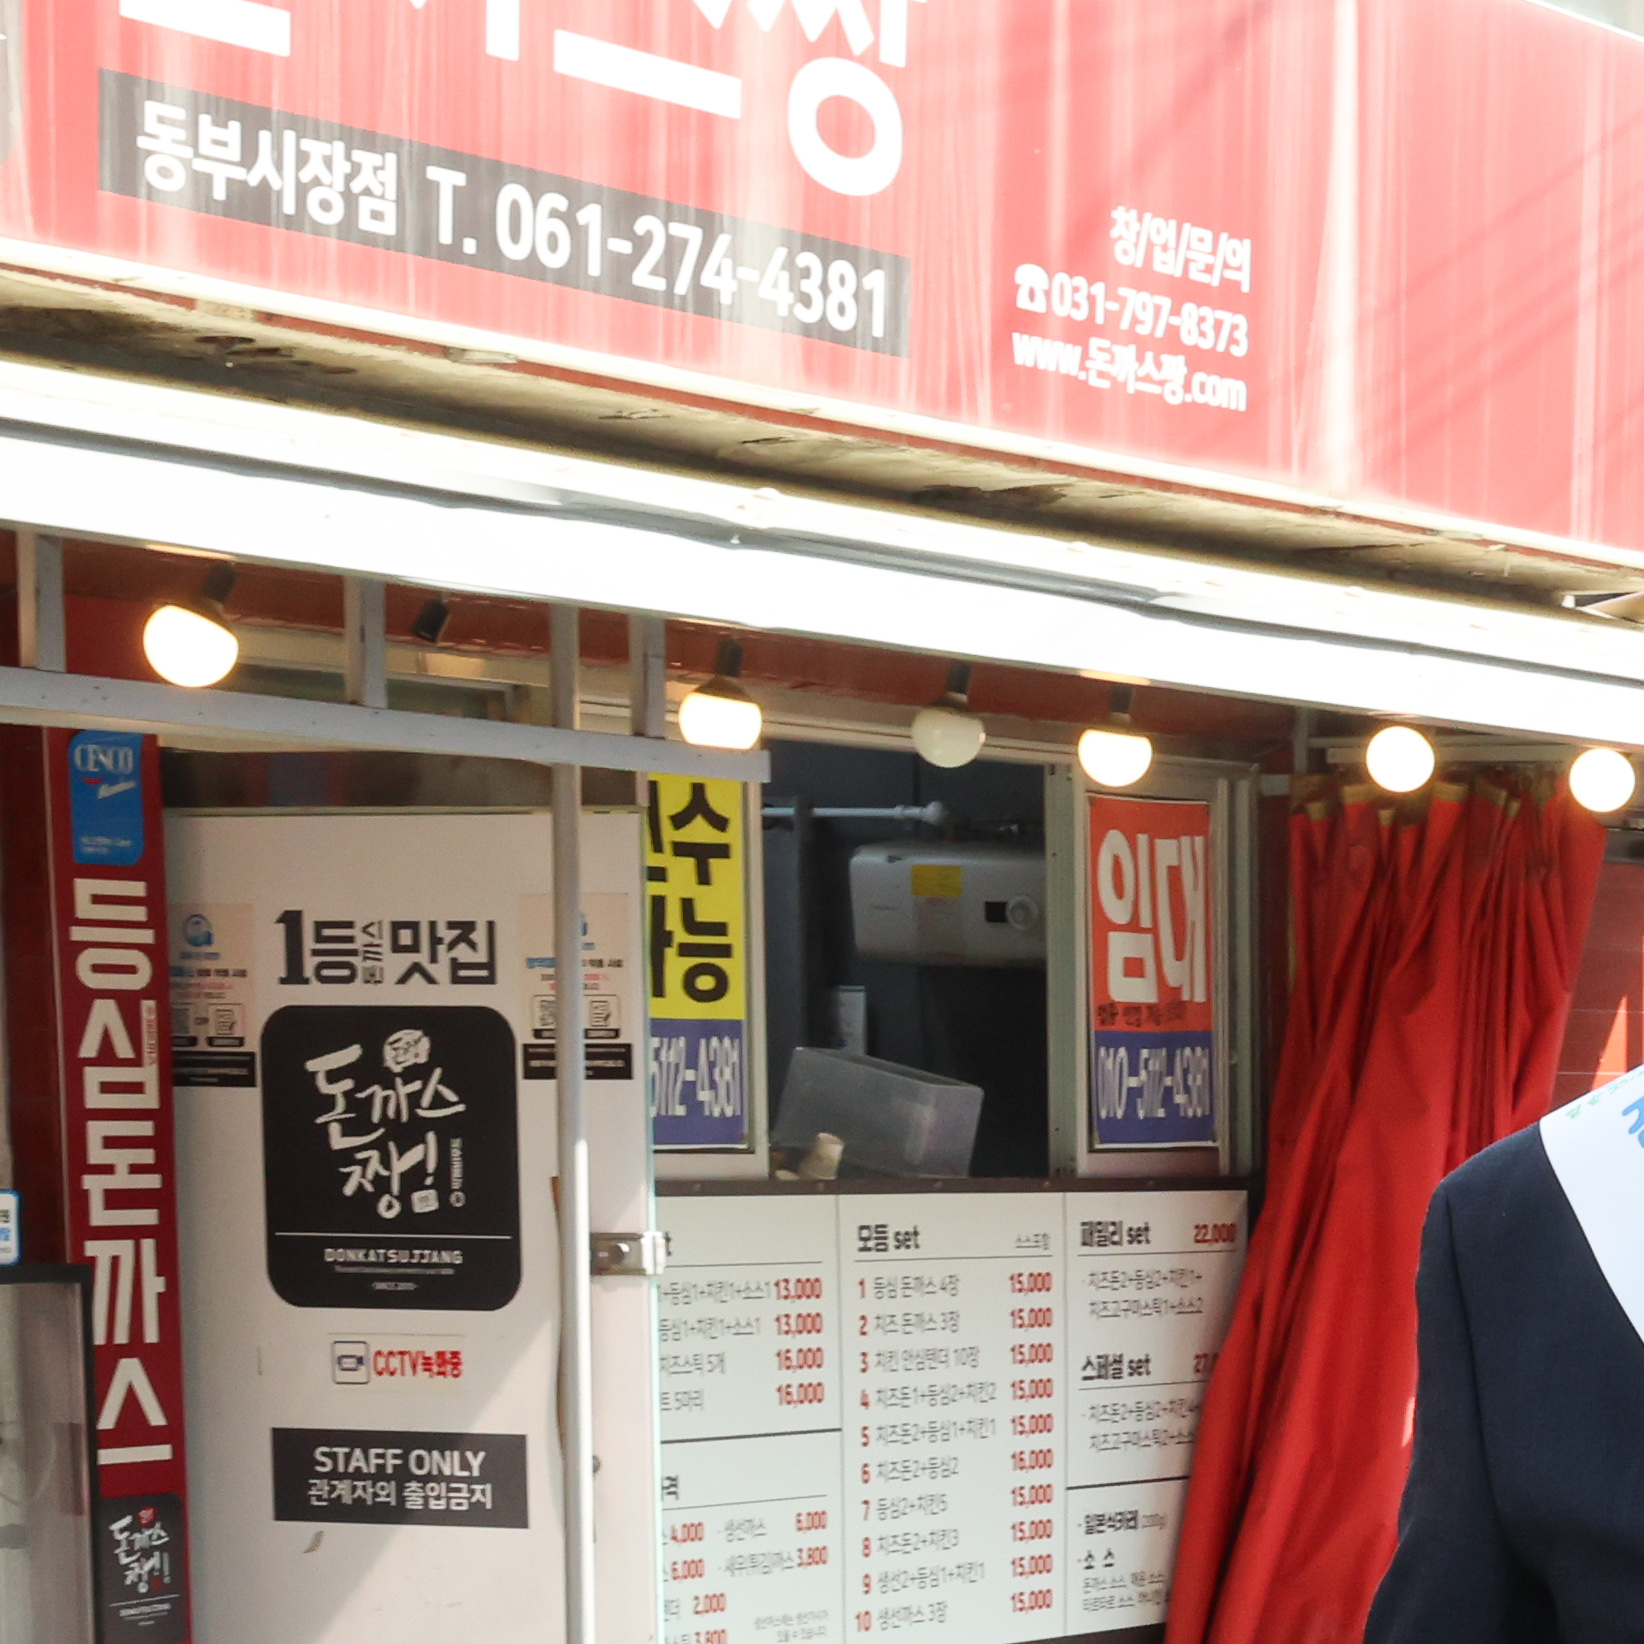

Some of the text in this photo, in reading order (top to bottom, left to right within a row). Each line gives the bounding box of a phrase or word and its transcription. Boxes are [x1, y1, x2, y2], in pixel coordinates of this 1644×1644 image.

[137, 99, 888, 339] 동부시장점 T. 061-274-4381
[1110, 205, 1252, 293] 창/업/문/의
[1051, 275, 1248, 357] 031-797-8373
[1012, 332, 1248, 412] www.돈까스짱.com
[1099, 828, 1207, 1004] 임대
[272, 909, 361, 986] 1등
[391, 919, 497, 986] 맛집
[304, 1043, 467, 1151] 돈까스
[70, 877, 174, 1467] 등심돈까스
[894, 1224, 921, 1251] set
[1127, 1221, 1151, 1245] set
[1193, 1222, 1238, 1245] 22,000
[323, 1248, 464, 1264] DONKATSUJJANG
[774, 1276, 823, 1304] 13,000
[858, 1277, 868, 1300] 1
[1009, 1271, 1053, 1296] 15,000
[774, 1311, 823, 1339] 13,000
[858, 1314, 869, 1337] 2
[1009, 1306, 1054, 1332] 15,000
[859, 1351, 869, 1374] 3
[1009, 1342, 1054, 1368] 15,000
[1081, 1352, 1152, 1381] 스페셜 set
[860, 1388, 870, 1410] 4
[1010, 1377, 1054, 1404] 15,000
[860, 1425, 871, 1447] 5
[1010, 1412, 1054, 1438] 15,000
[313, 1445, 486, 1477] STAFF ONLY
[861, 1462, 871, 1485] 6
[307, 1478, 493, 1511] 관계자외 출입금지
[861, 1499, 871, 1522] 7
[1010, 1483, 1054, 1509] 15,000
[862, 1536, 872, 1558] 8
[1010, 1518, 1054, 1545] 15,000
[862, 1573, 872, 1596] 9
[1010, 1552, 1054, 1580] 15,000
[693, 1592, 727, 1617] 2,000
[855, 1609, 872, 1633] 10
[1010, 1588, 1054, 1616] 15,000
